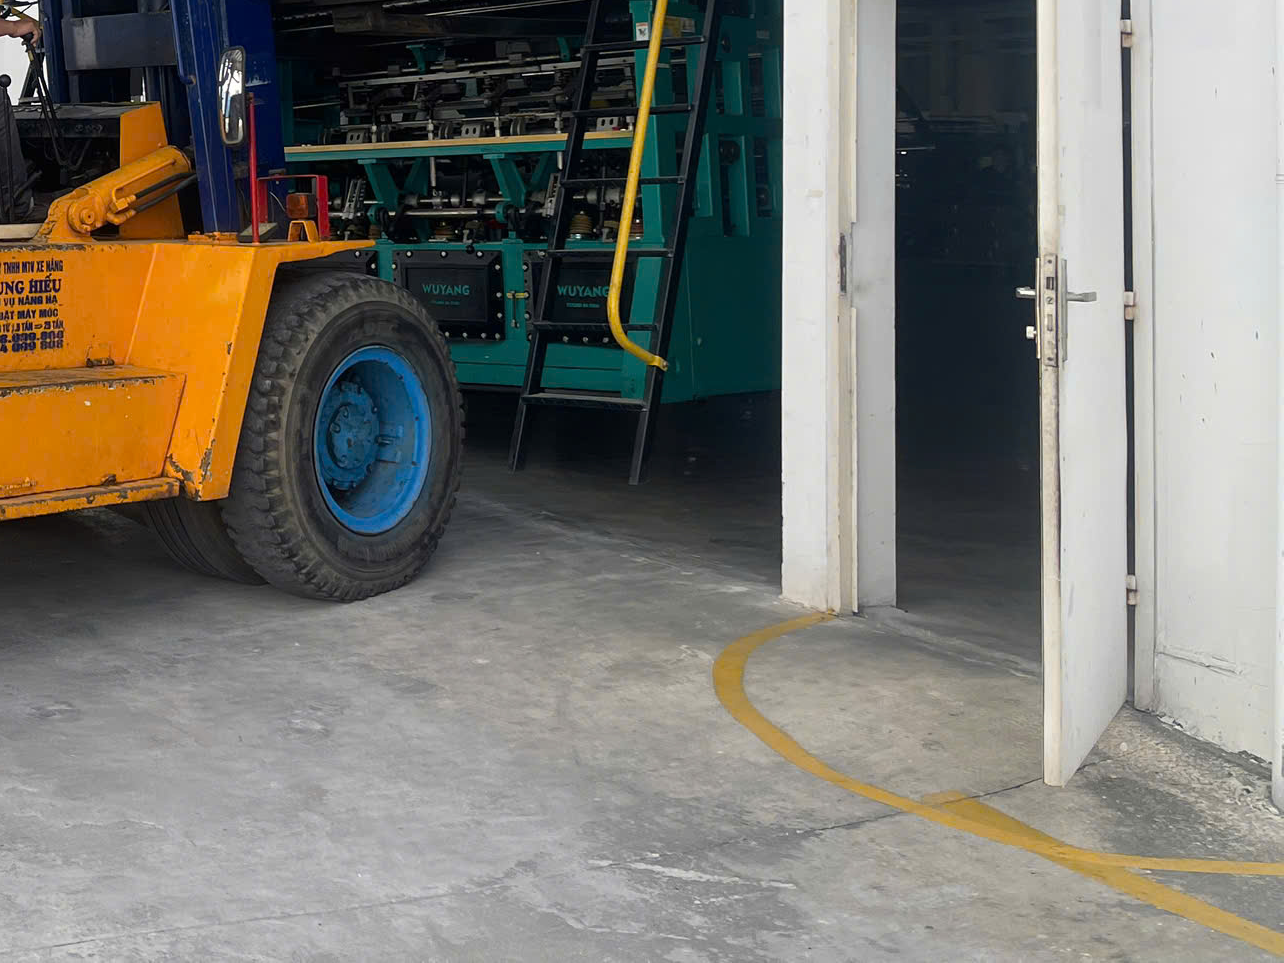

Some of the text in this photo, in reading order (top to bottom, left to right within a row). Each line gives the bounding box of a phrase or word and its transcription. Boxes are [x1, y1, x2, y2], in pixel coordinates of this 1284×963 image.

[36, 261, 45, 272] XE
[422, 284, 470, 296] WUYANG
[557, 285, 610, 298] WUYANG
